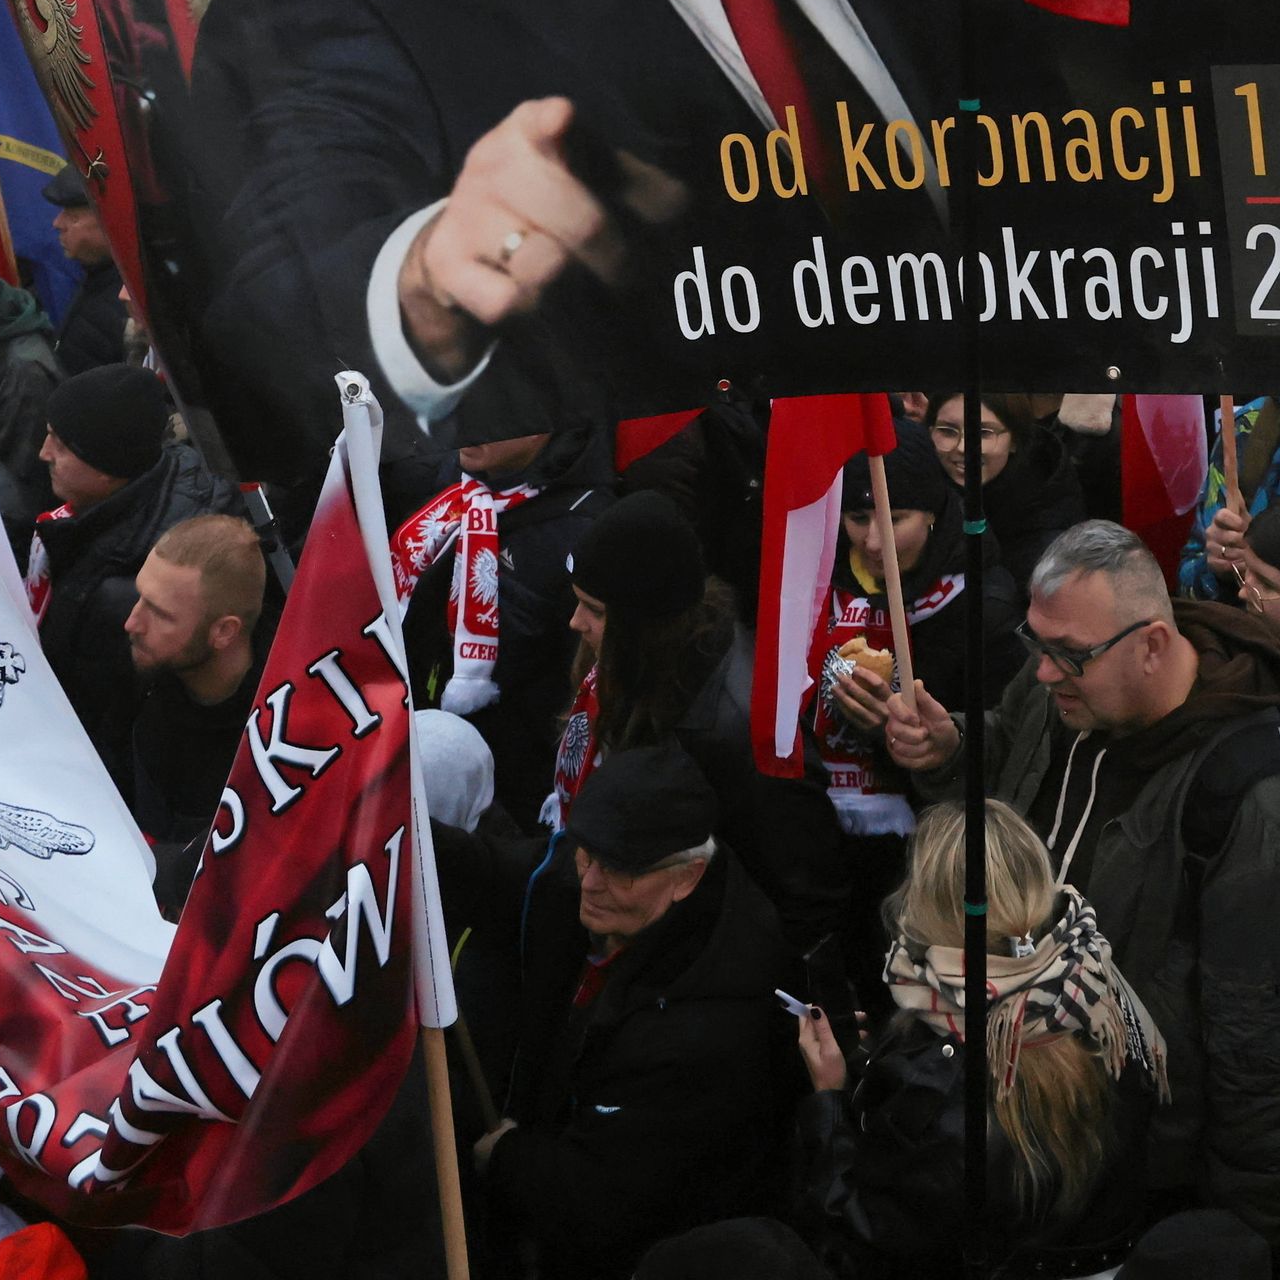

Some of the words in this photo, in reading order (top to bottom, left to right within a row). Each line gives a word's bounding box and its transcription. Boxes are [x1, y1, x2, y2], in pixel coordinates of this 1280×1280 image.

[719, 105, 808, 203] od
[836, 79, 1203, 203] koronacji
[673, 245, 761, 341] do
[792, 221, 1221, 344] demokracji
